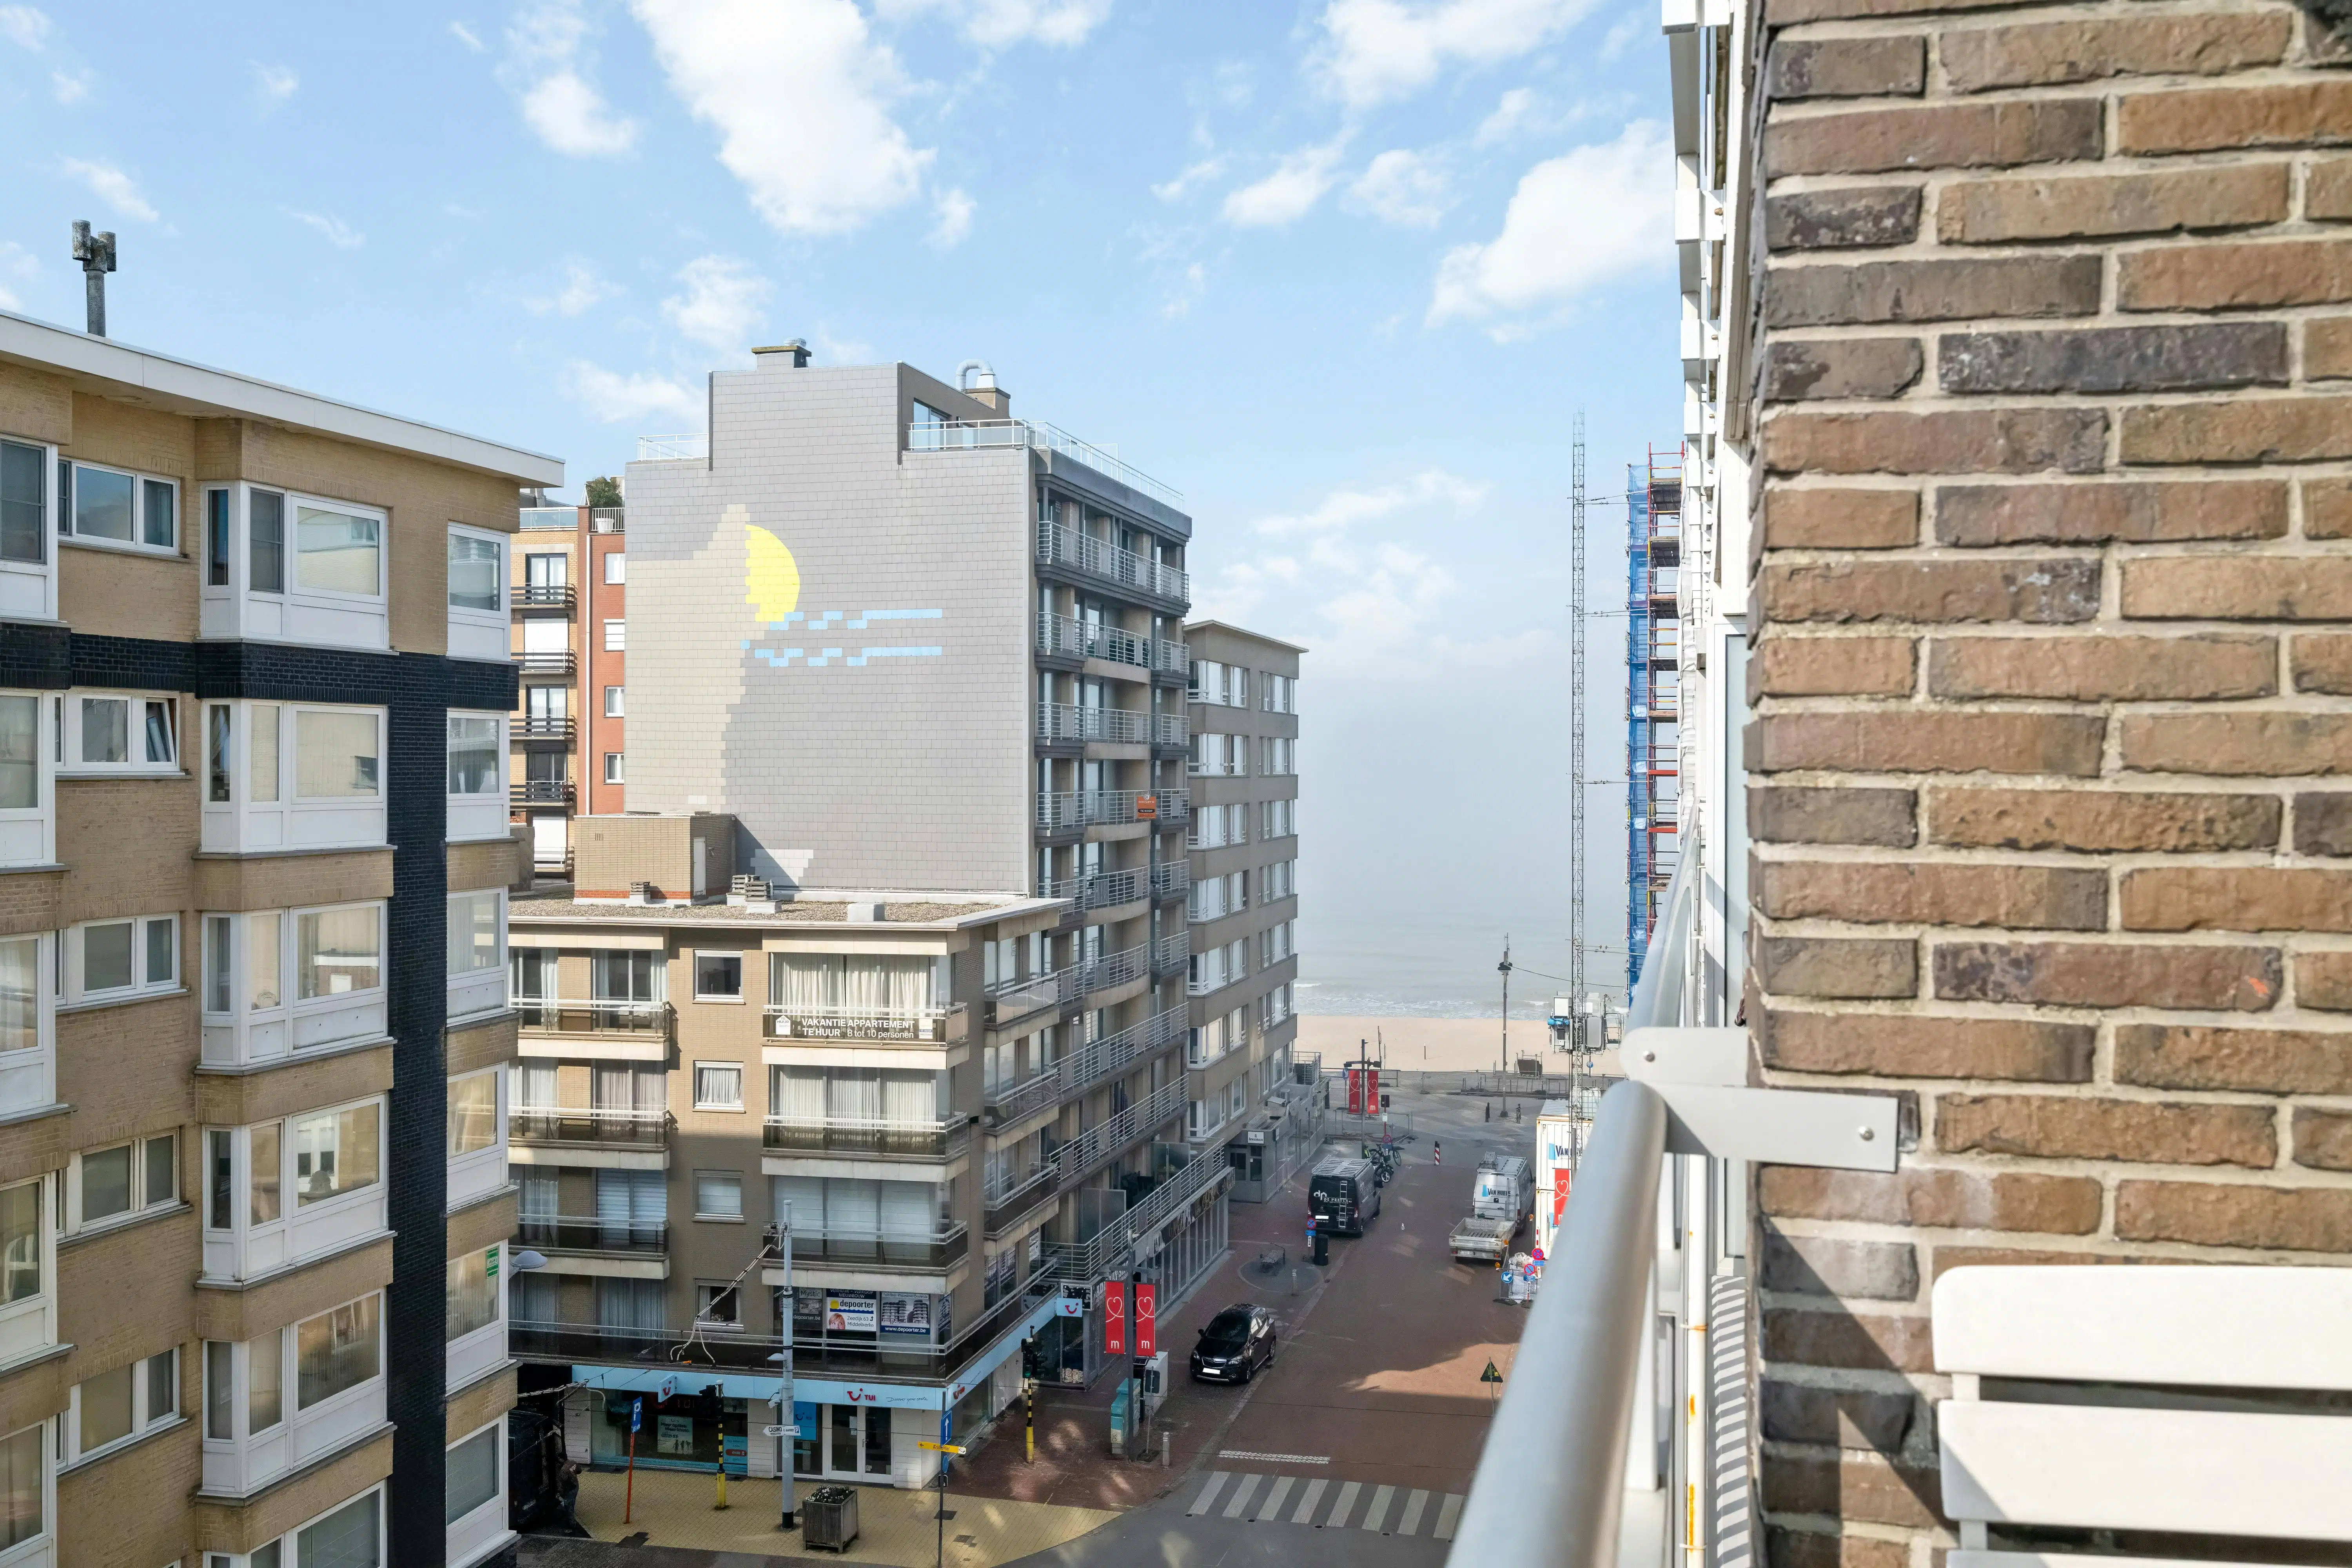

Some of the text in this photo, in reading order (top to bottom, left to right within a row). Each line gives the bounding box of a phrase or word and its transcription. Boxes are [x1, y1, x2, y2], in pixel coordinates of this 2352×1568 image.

[801, 1018, 915, 1028] VAKANTIE APPARTEMENT
[815, 1028, 840, 1036] HUUR
[840, 1299, 874, 1308] depoorter
[1111, 1340, 1120, 1348] m
[1141, 1340, 1150, 1348] m
